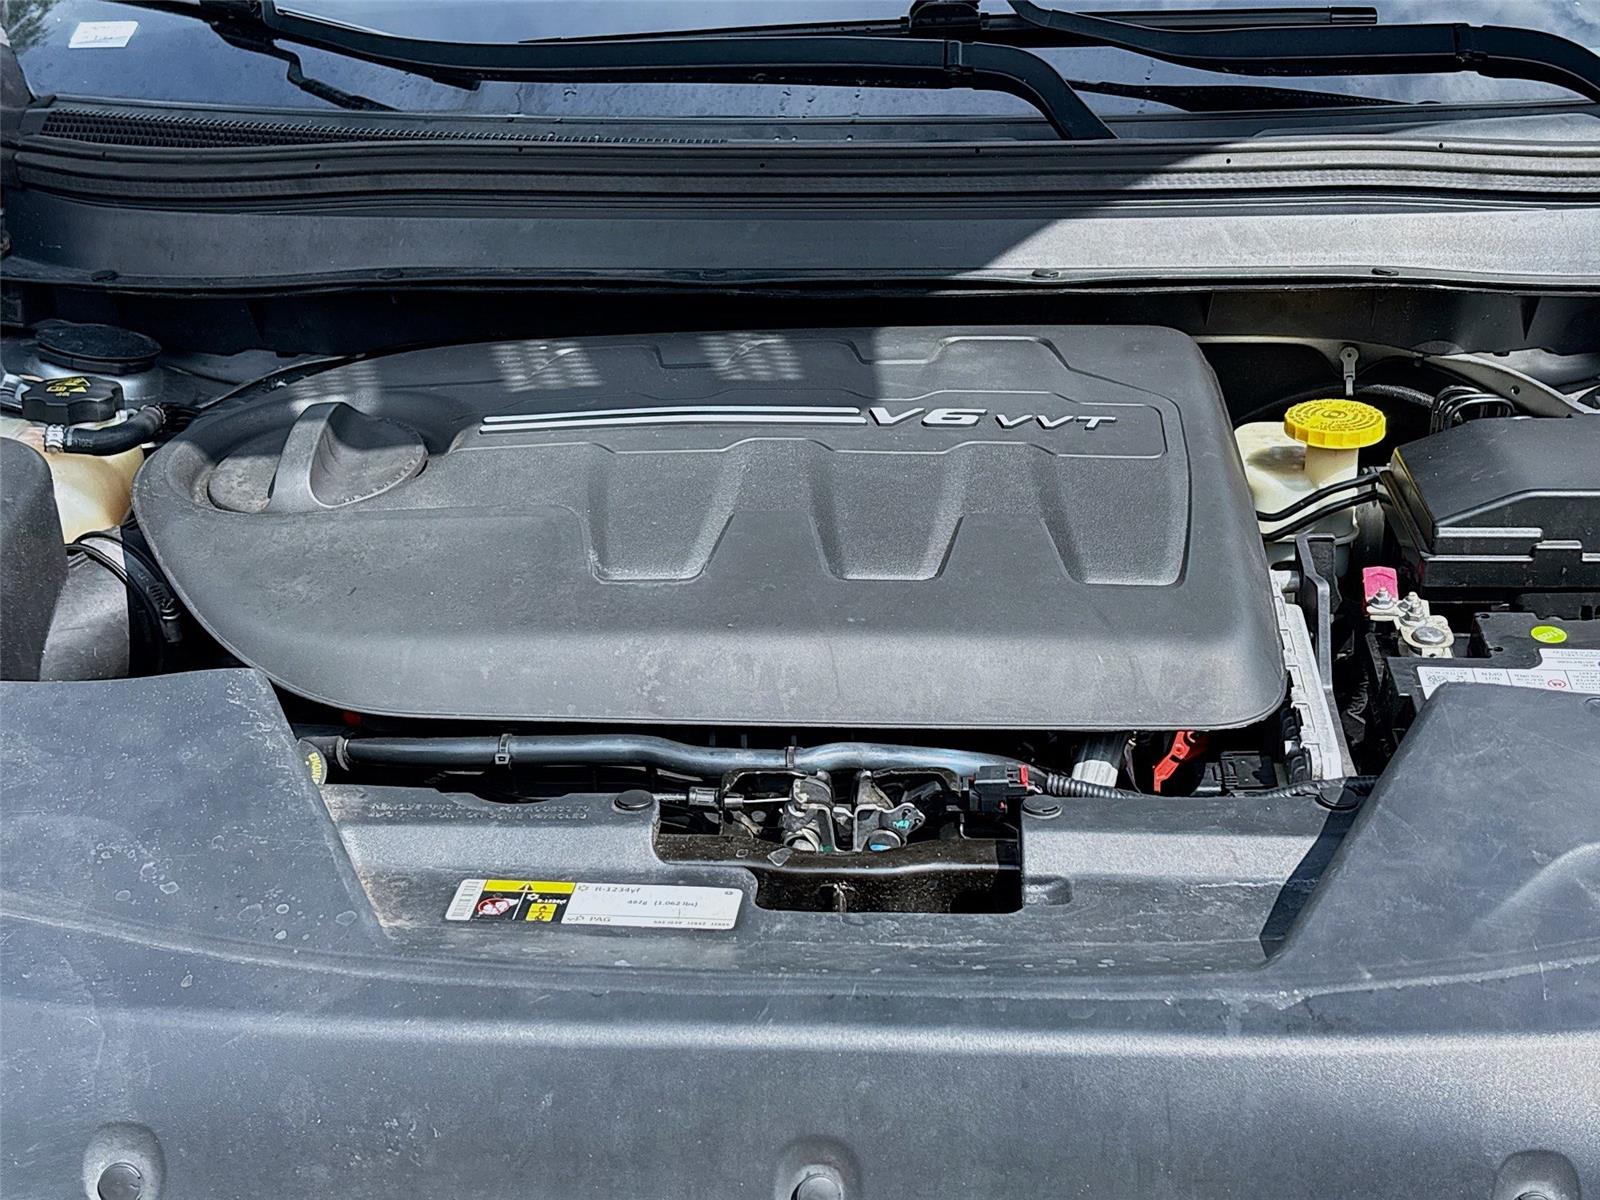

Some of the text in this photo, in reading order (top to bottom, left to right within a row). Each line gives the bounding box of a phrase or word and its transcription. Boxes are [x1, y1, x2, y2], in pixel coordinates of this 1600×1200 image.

[869, 407, 1117, 431] V6 VVT
[594, 886, 641, 895] R-1234yf
